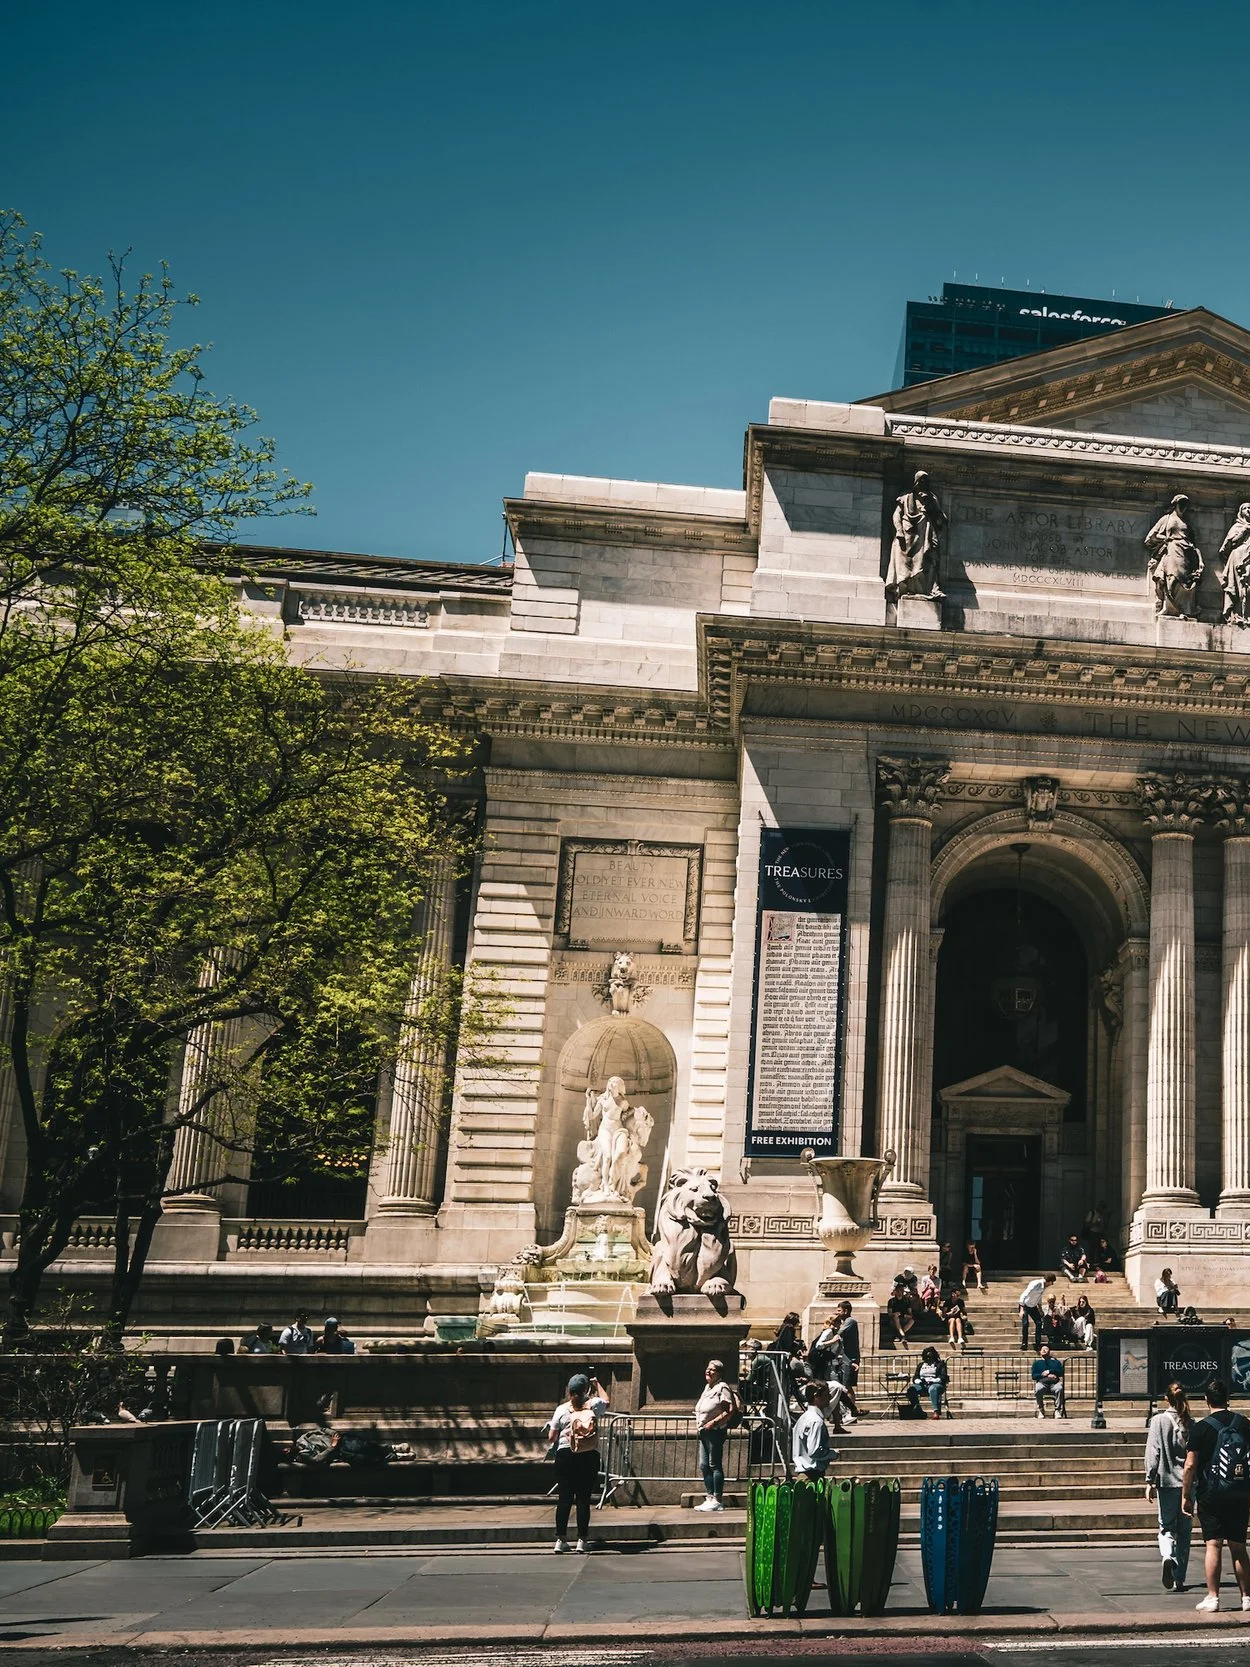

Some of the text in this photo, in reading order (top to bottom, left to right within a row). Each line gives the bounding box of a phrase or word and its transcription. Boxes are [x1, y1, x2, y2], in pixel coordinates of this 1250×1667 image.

[962, 505, 1136, 533] THE ASTOR LIBRARY
[983, 538, 1113, 558] JOHN JACOB ASTOR
[1049, 566, 1081, 577] USEFUL
[890, 704, 1016, 726] MDCCCXCV
[1085, 711, 1152, 738] THE
[610, 860, 656, 871] BEAUTY
[764, 865, 843, 880] TREASURES
[576, 875, 686, 889] OLD YET EVER NEW
[582, 891, 678, 904] ETERNAL VOICE
[572, 906, 684, 920] AND INWARD WORD
[751, 1136, 832, 1146] FREE EXHIBITION
[1163, 1360, 1218, 1370] TREASURES
